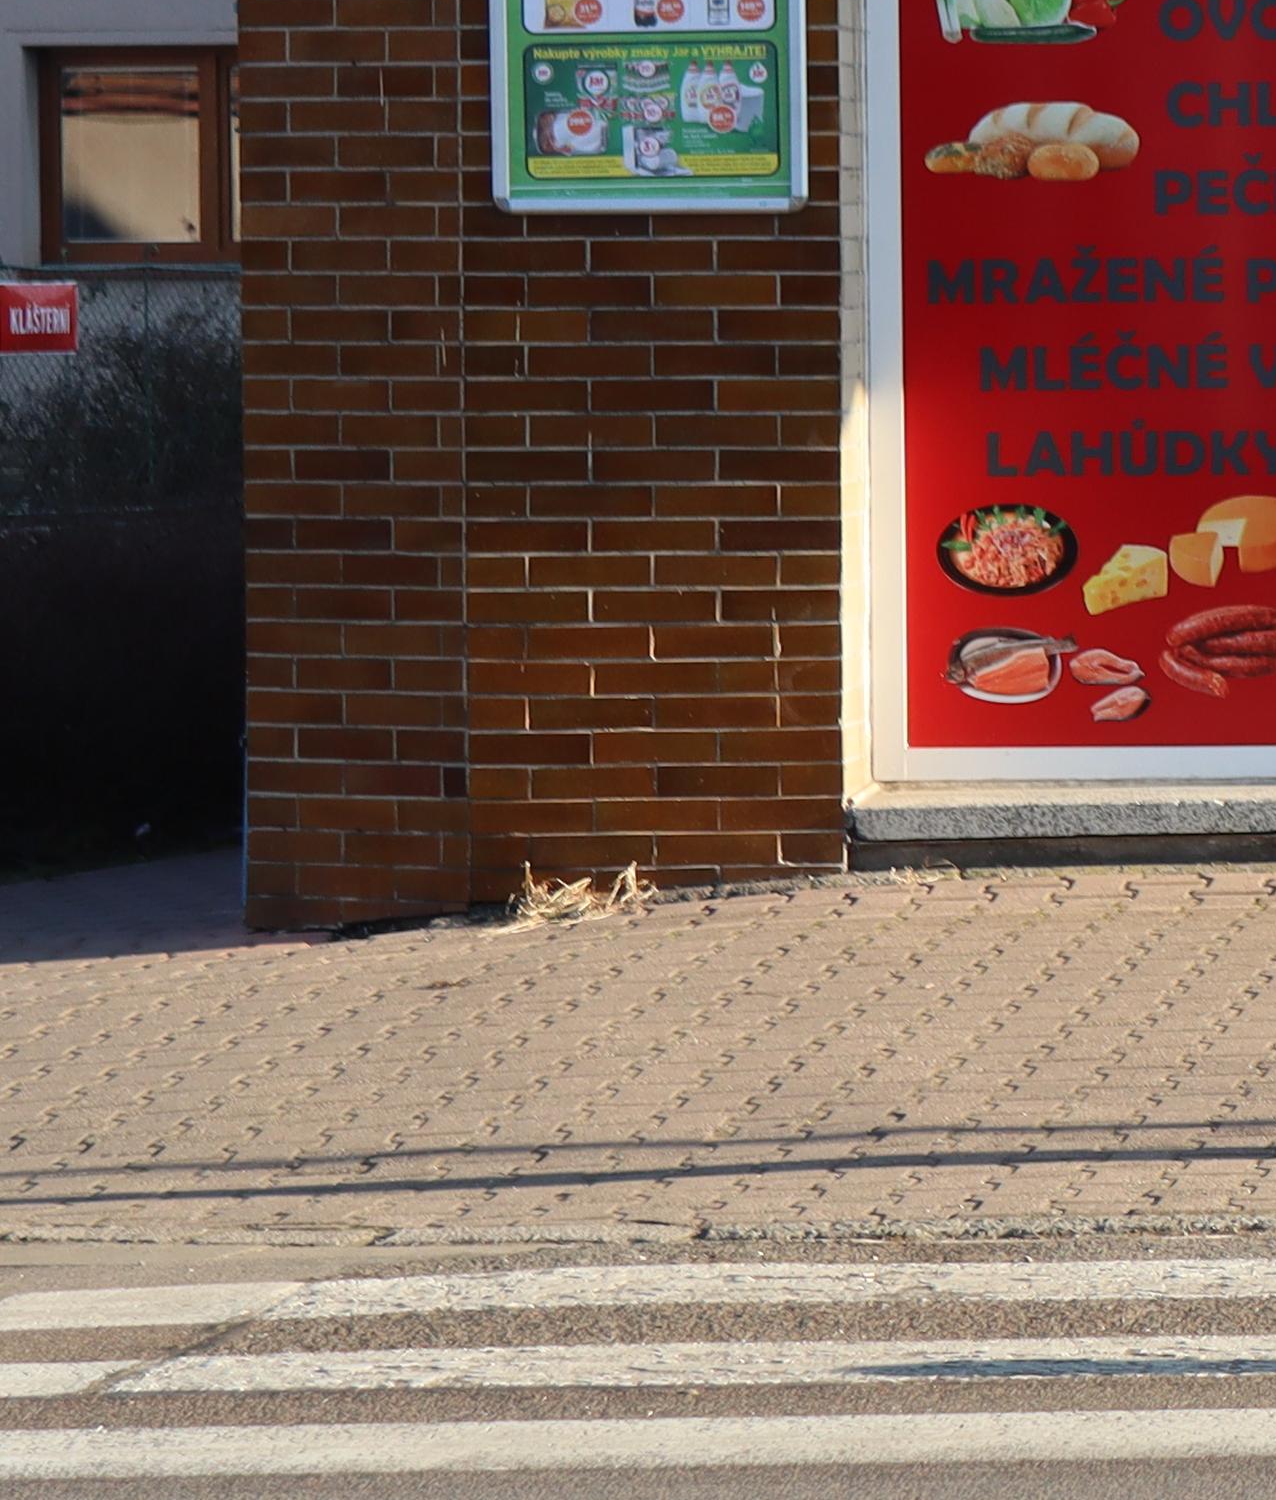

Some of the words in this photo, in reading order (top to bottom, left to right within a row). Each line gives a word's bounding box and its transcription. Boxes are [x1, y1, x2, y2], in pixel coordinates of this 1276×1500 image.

[926, 245, 1225, 304] MRAŽENÉ
[9, 302, 71, 334] KLÁŠTERNÍ
[978, 330, 1229, 392] MLÉČNÉ
